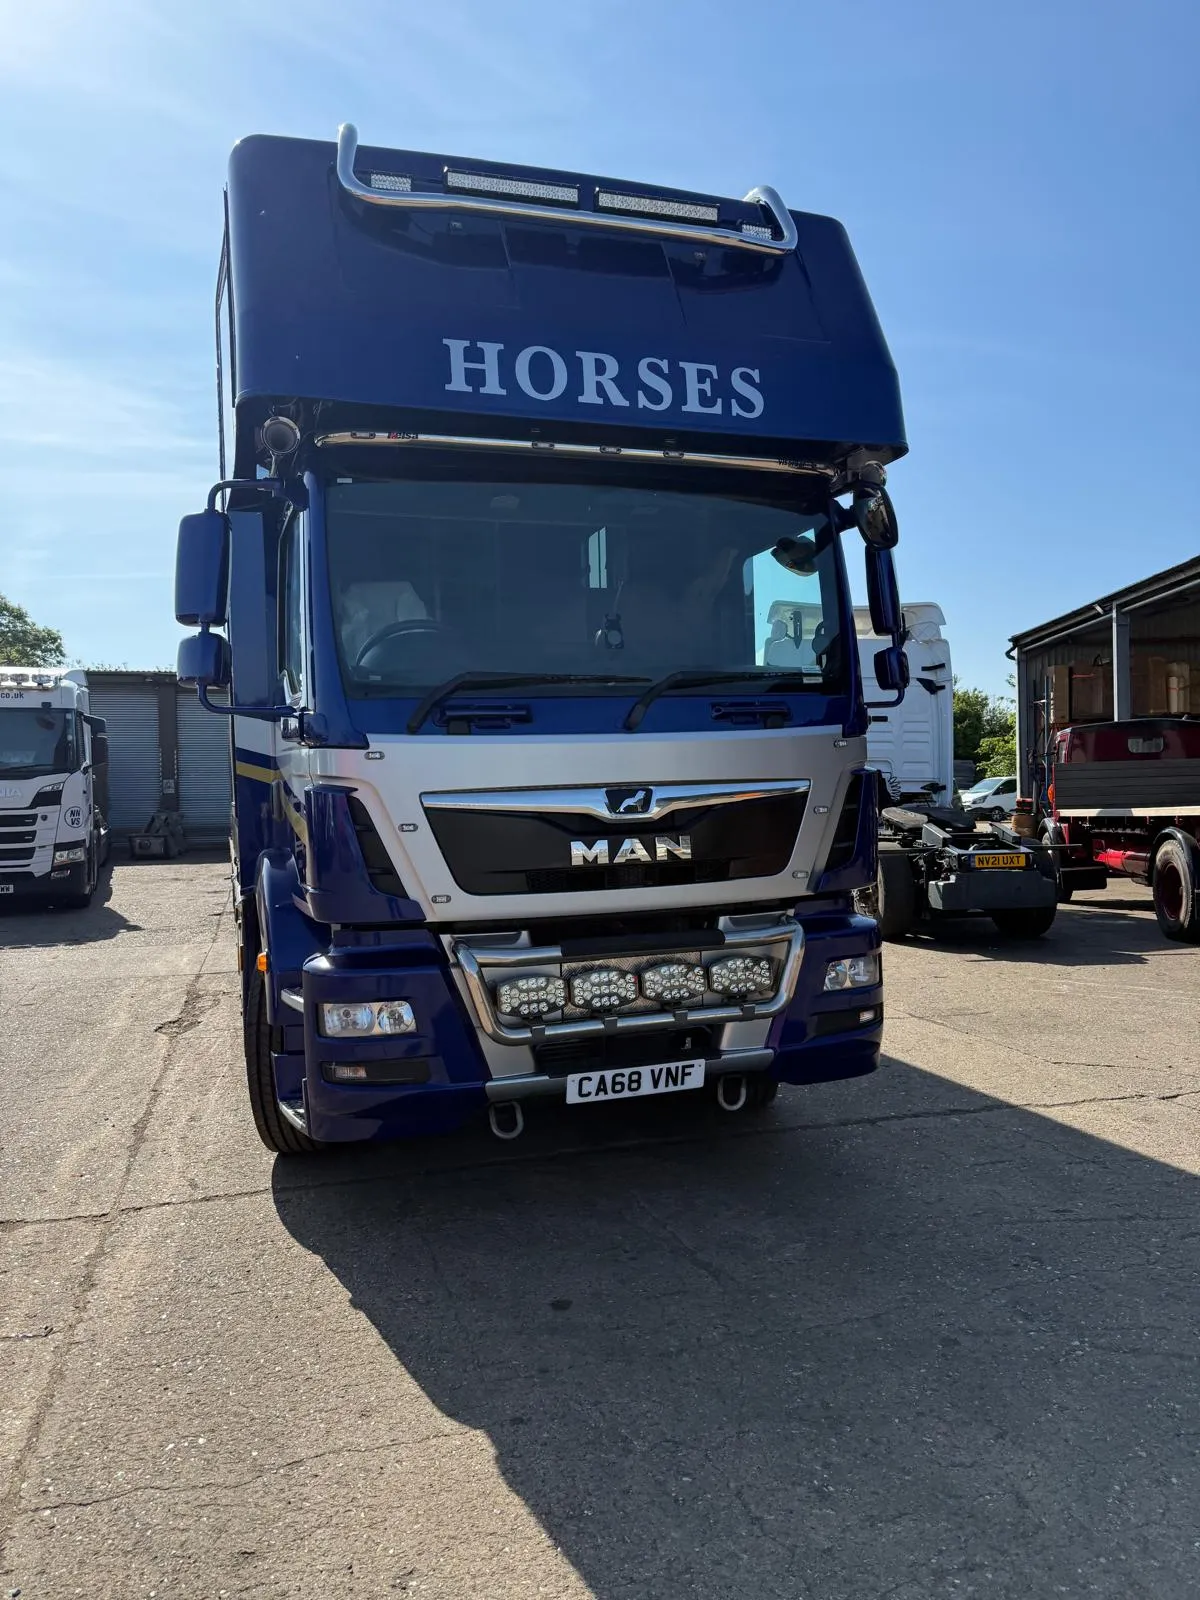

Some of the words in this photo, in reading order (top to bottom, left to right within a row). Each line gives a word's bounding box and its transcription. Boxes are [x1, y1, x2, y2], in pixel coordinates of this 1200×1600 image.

[442, 338, 765, 419] HORSES
[570, 835, 692, 866] MAN
[977, 855, 1000, 866] NV21
[1002, 855, 1021, 865] UXT
[577, 1070, 642, 1098] CA68
[650, 1063, 695, 1089] VNF
